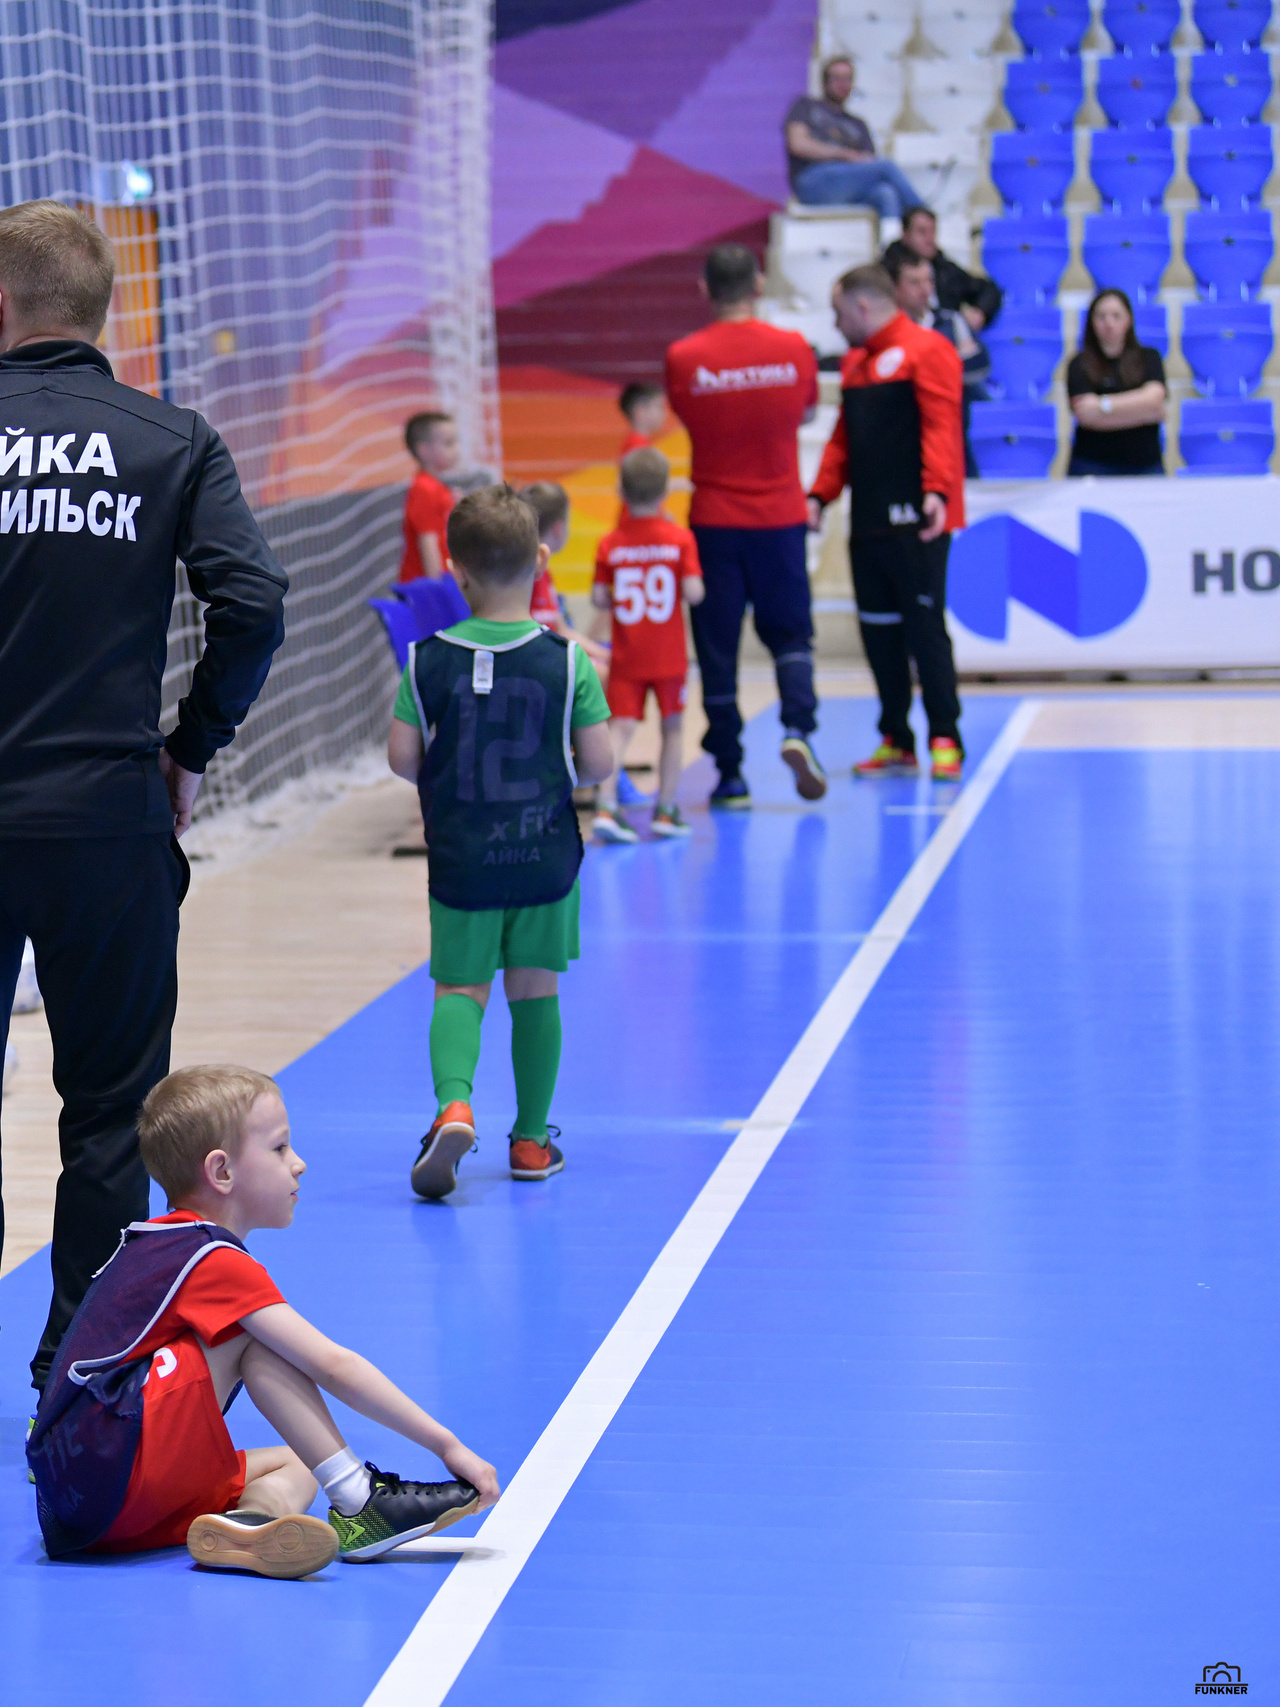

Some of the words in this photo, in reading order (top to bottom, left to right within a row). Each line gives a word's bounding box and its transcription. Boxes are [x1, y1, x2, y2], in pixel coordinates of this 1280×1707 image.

[614, 564, 676, 625] 59
[453, 674, 547, 802] 12
[483, 846, 542, 866] АЙКА
